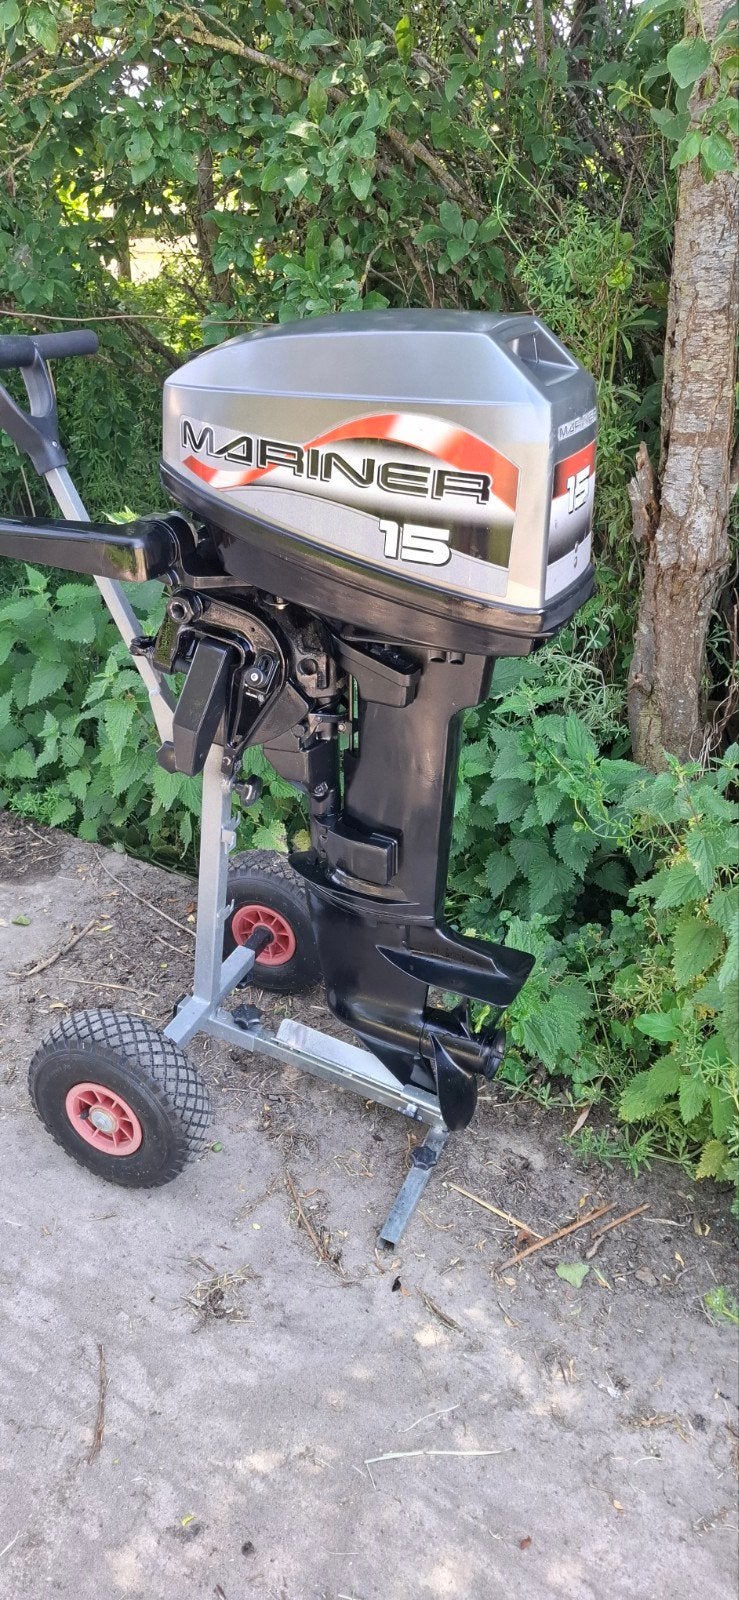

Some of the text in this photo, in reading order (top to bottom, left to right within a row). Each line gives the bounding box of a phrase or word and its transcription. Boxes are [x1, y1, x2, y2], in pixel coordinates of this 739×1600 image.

[181, 418, 492, 505] MARINER
[567, 465, 591, 515] 15
[378, 519, 452, 566] 15
